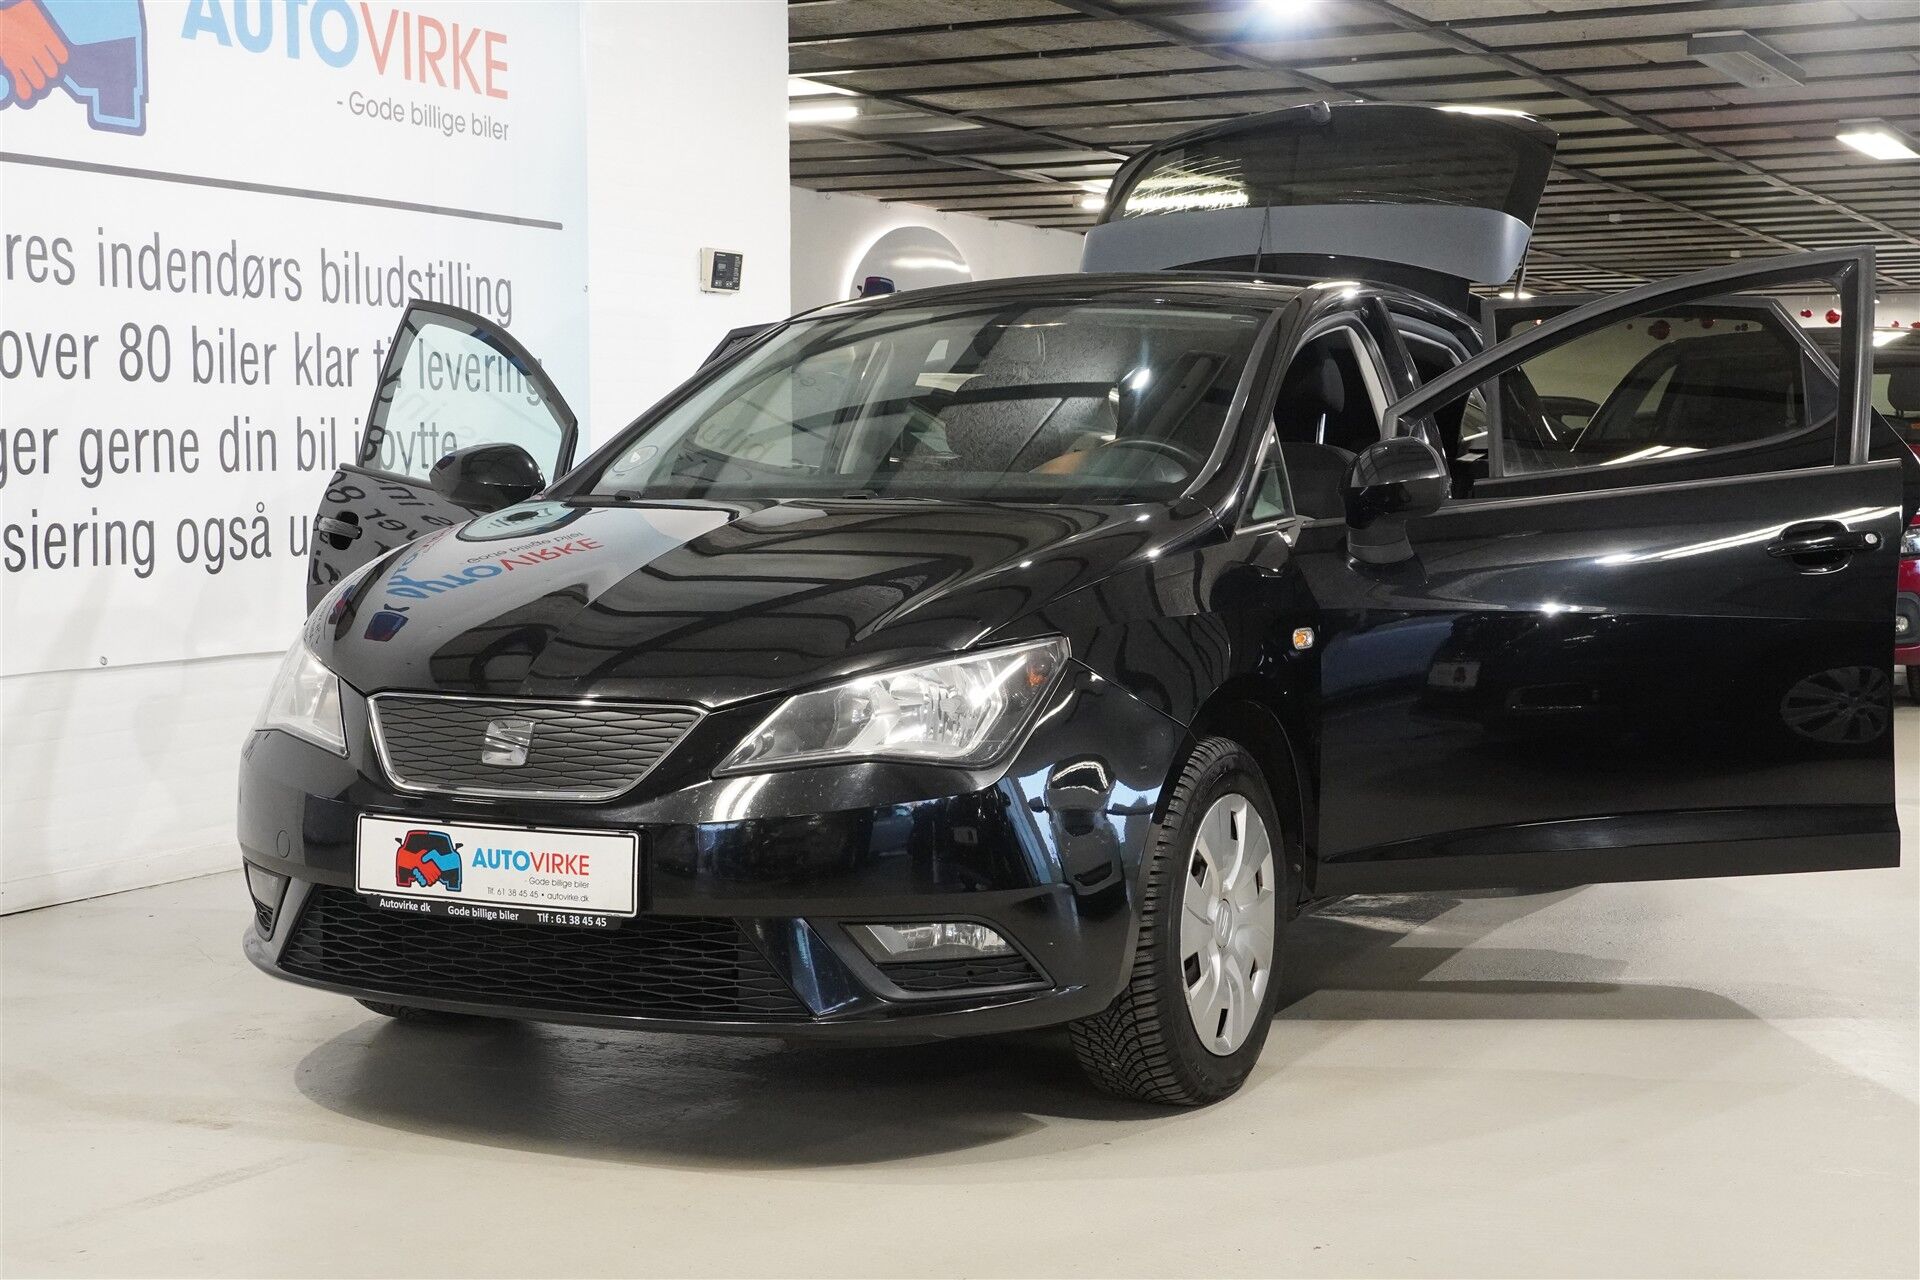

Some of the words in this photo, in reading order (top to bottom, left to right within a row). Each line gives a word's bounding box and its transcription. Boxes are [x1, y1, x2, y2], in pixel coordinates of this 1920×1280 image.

[350, 91, 404, 122] Gode
[412, 102, 466, 136] billige
[472, 113, 508, 141] biler
[6, 233, 76, 286] res
[98, 227, 302, 302] indendørs
[320, 248, 512, 328] biludstilling
[0, 330, 99, 380] over
[119, 322, 171, 383] 80
[192, 326, 277, 386] biler
[295, 332, 360, 388] klar
[80, 426, 200, 489] gerne
[219, 416, 277, 473] din
[297, 416, 336, 471] bil
[3, 507, 154, 579] siering
[177, 502, 272, 576] også
[472, 847, 590, 876] AUTOVIRKE
[528, 876, 550, 886] Gode
[551, 877, 573, 888] billige
[574, 880, 590, 888] biler
[379, 898, 418, 911] Autovirke
[420, 902, 431, 912] dk
[447, 905, 470, 916] Gode
[472, 907, 497, 920] billige
[499, 909, 520, 921] biler
[556, 914, 567, 924] 61
[569, 915, 580, 925] 38
[582, 916, 593, 926] 45
[595, 917, 607, 927] 45
[497, 887, 505, 895] 61
[507, 888, 517, 897] 38
[518, 889, 528, 898] 45
[530, 890, 539, 899] 45
